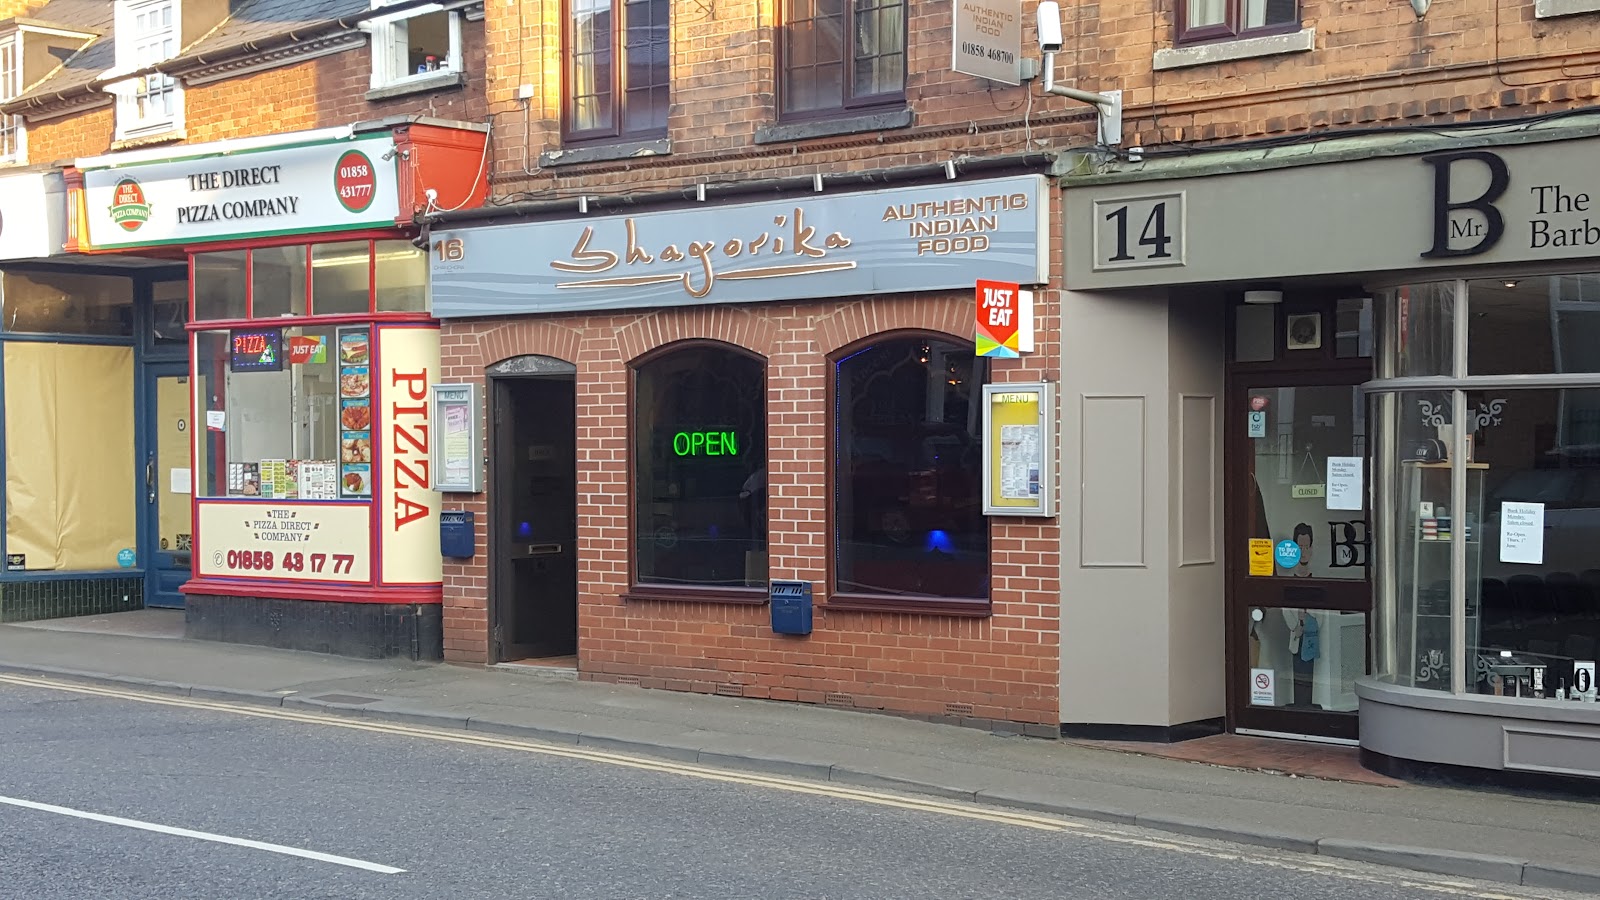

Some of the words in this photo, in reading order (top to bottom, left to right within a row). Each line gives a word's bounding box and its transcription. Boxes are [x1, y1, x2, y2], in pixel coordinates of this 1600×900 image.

[963, 3, 1013, 22] AUTHENTIC
[972, 14, 1003, 29] INDIAN
[976, 24, 1000, 37] FOOD
[962, 41, 985, 58] 01858
[987, 47, 1014, 64] 468700
[188, 171, 220, 191] THE
[223, 164, 281, 188] DIRECT
[341, 164, 368, 179] 01858
[118, 193, 138, 204] DIRECT
[122, 184, 133, 194] THE
[340, 184, 372, 199] 431777
[1530, 185, 1590, 214] The
[177, 203, 220, 224] PIZZA
[222, 196, 299, 219] COMPANY
[882, 193, 1028, 222] AUTHENTIC
[1420, 151, 1510, 258] B
[909, 214, 998, 238] INDIAN
[1105, 202, 1172, 262] 14
[1450, 218, 1487, 239] Mr.
[1529, 218, 1600, 249] Barb
[433, 238, 464, 262] 16
[550, 207, 852, 297] Shagorika
[917, 235, 990, 257] FOOD
[982, 287, 1013, 309] JUST
[988, 308, 1013, 327] EAT
[234, 335, 267, 355] PIZZA
[292, 344, 309, 356] JUST
[309, 344, 323, 354] EAT
[444, 390, 464, 400] MENU
[1001, 394, 1029, 404] MENU
[392, 367, 430, 532] PIZZA
[674, 432, 737, 456] OPEN
[1298, 488, 1318, 496] CLOSED
[253, 520, 277, 530] PIZZA
[280, 521, 311, 530] DIRECT
[271, 510, 290, 519] THE
[261, 532, 303, 542] COMPANY
[227, 549, 274, 571] 01858
[282, 552, 304, 573] 43
[310, 553, 327, 573] 17
[332, 554, 355, 574] 77
